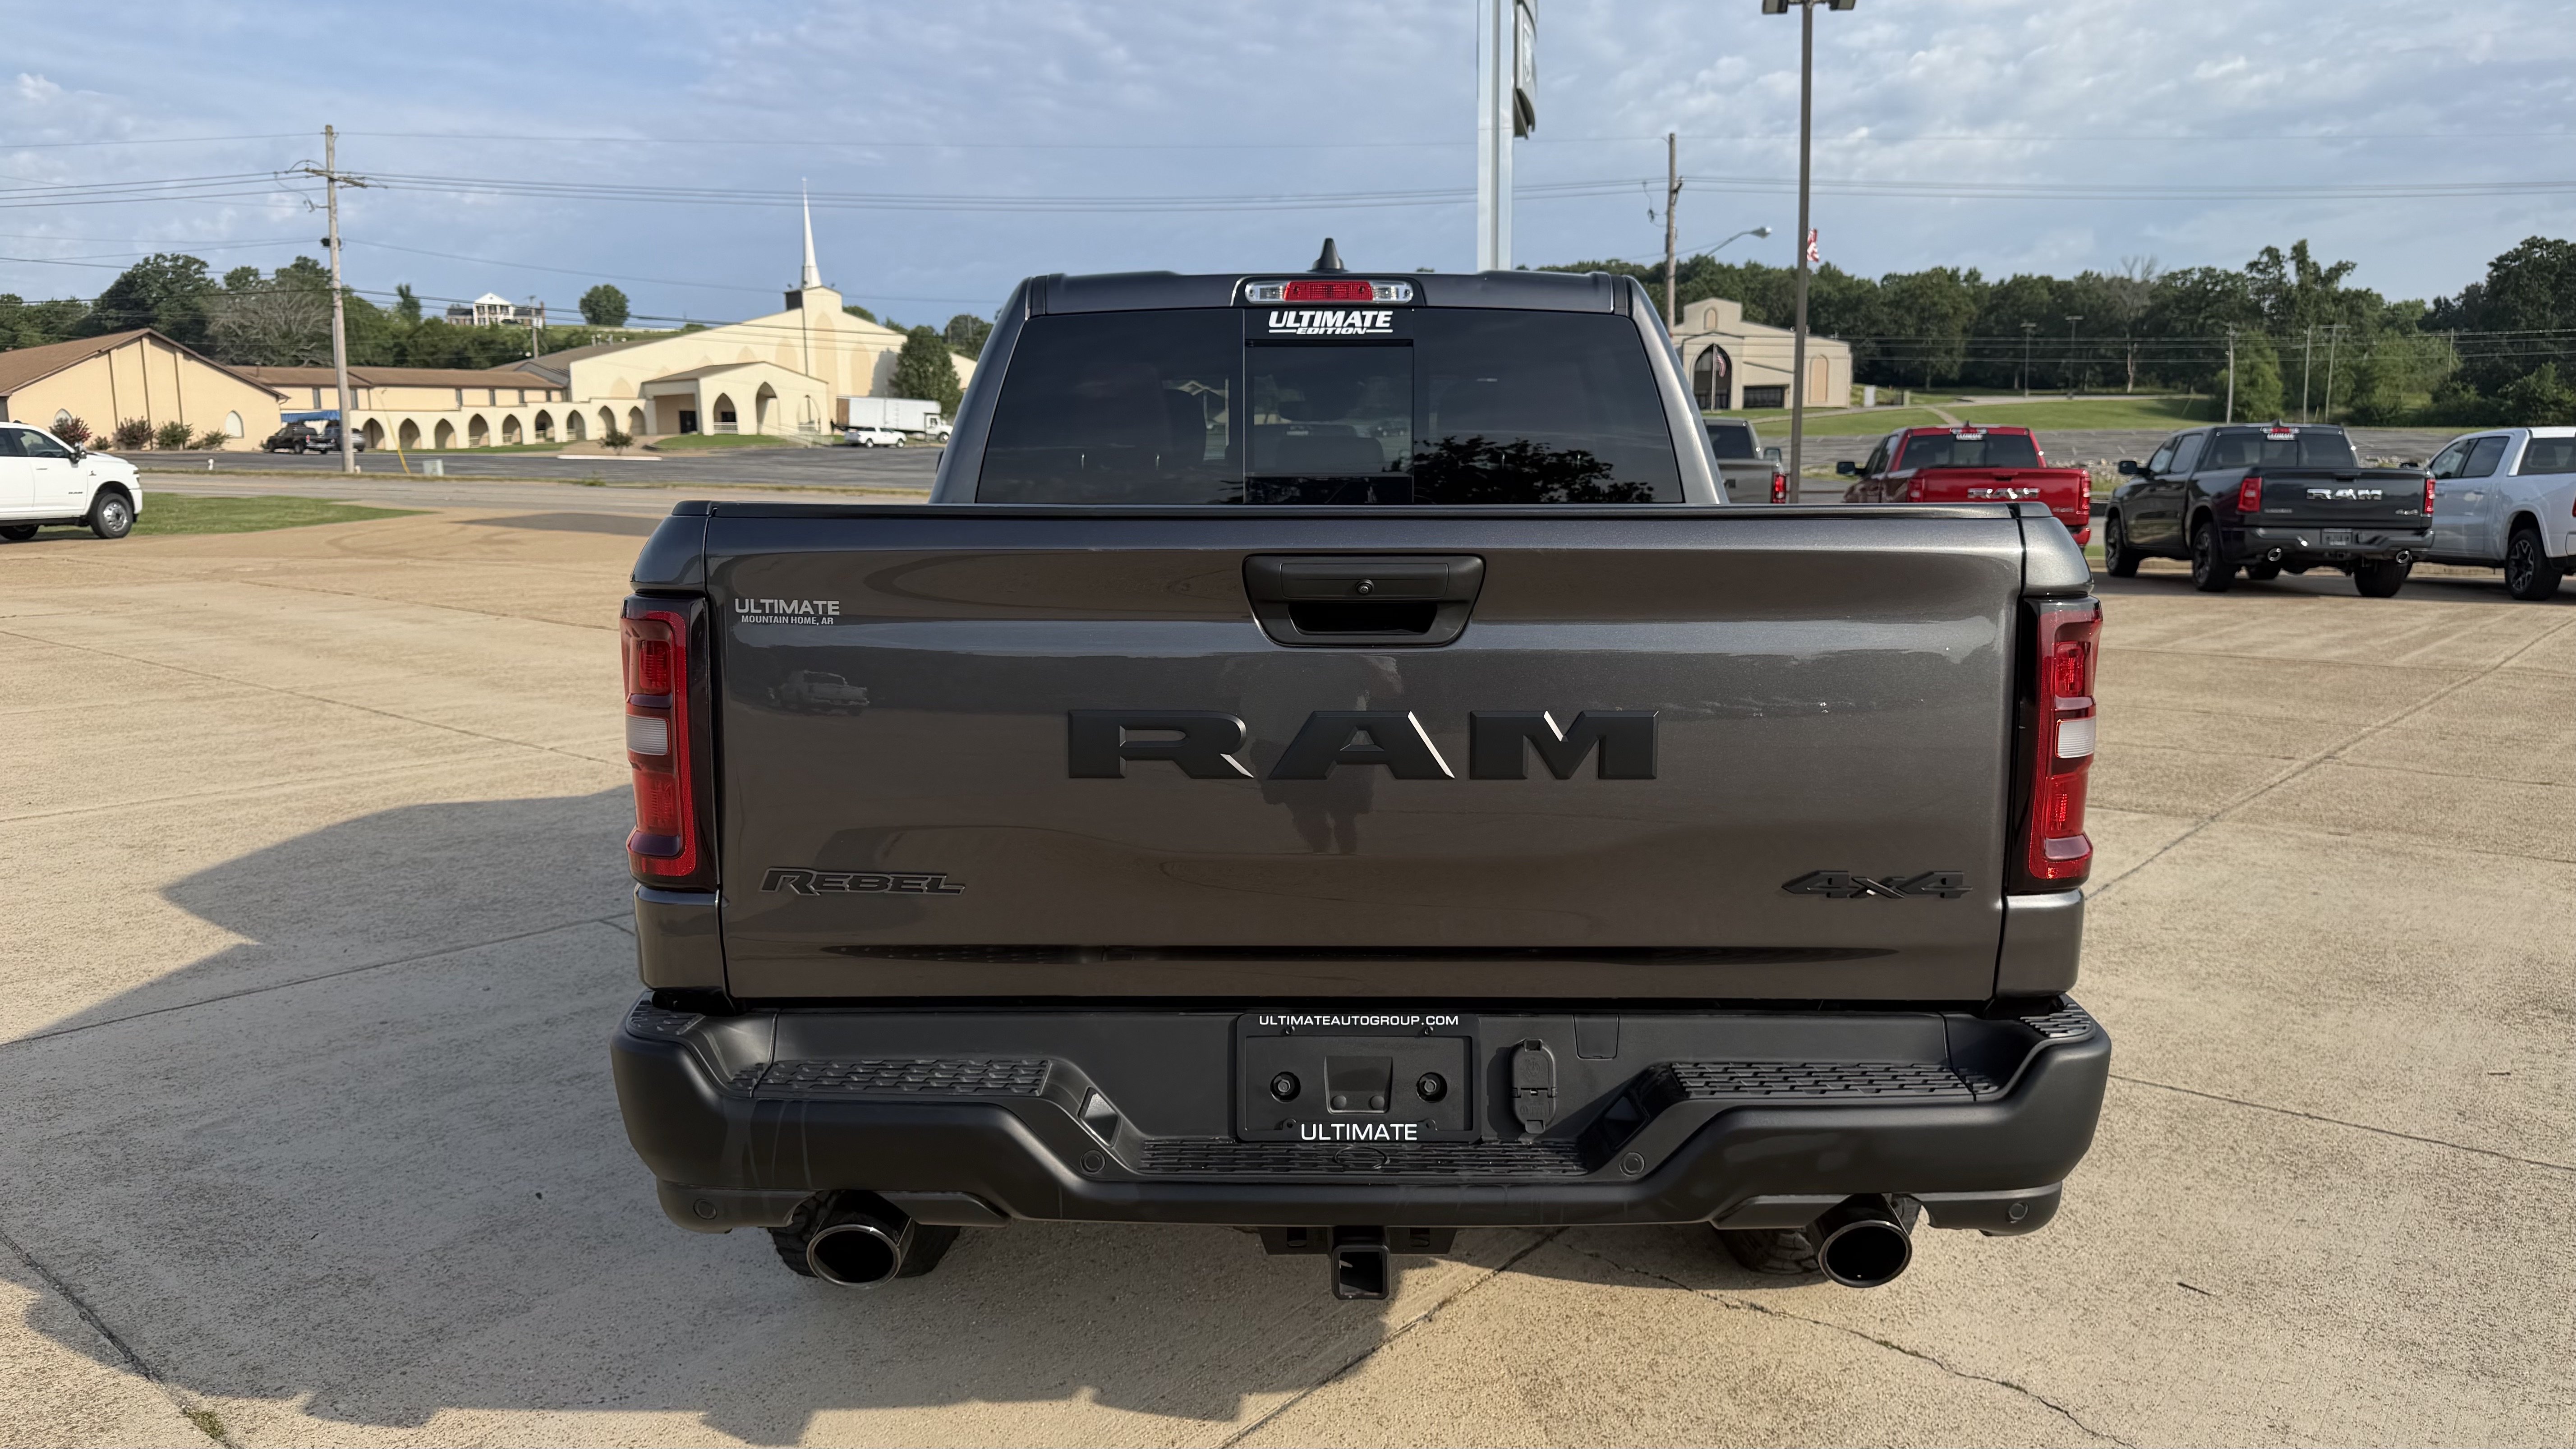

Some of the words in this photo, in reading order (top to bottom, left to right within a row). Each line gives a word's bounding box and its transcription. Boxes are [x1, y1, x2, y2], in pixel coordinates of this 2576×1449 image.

[1269, 311, 1393, 327] ULTIMATE
[2306, 488, 2383, 500] RAM
[735, 598, 840, 615] ULTIMATE
[741, 615, 789, 624] MOUNTAIN
[791, 616, 819, 626] HOME,
[1067, 709, 1660, 780] RAM
[759, 866, 965, 896] REBEL
[1259, 1015, 1458, 1026] ULTIMATEAUTOGROUP.COM
[1301, 1123, 1417, 1141] ULTIMATE
